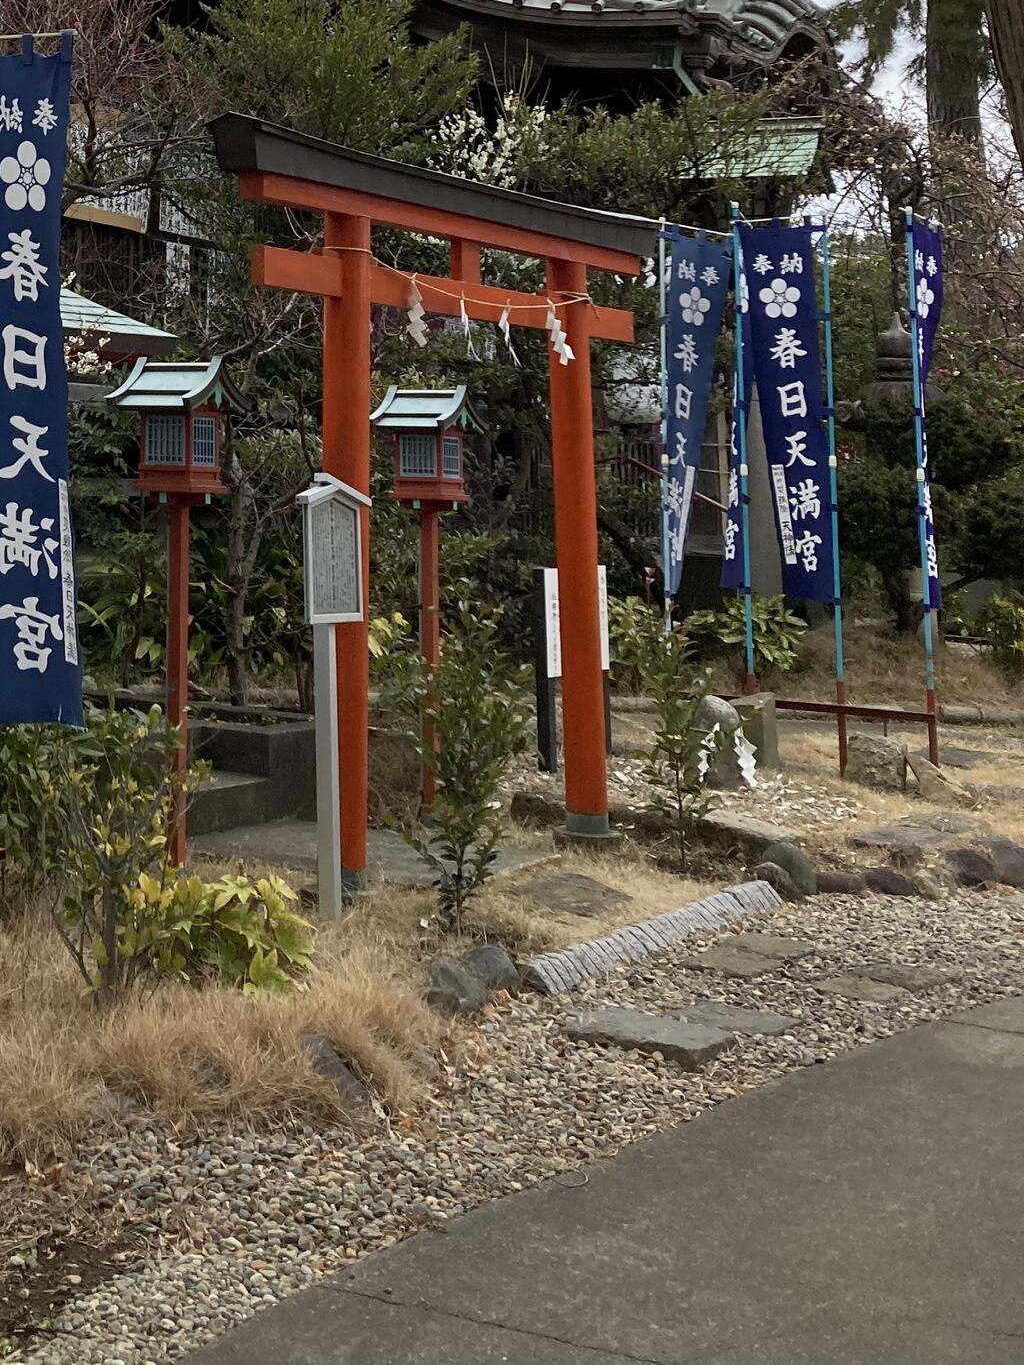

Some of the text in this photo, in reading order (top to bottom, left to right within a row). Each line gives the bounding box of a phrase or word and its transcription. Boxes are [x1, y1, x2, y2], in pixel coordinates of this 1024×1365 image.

[752, 252, 803, 275] 奉納
[770, 328, 822, 572] 春日天満宮
